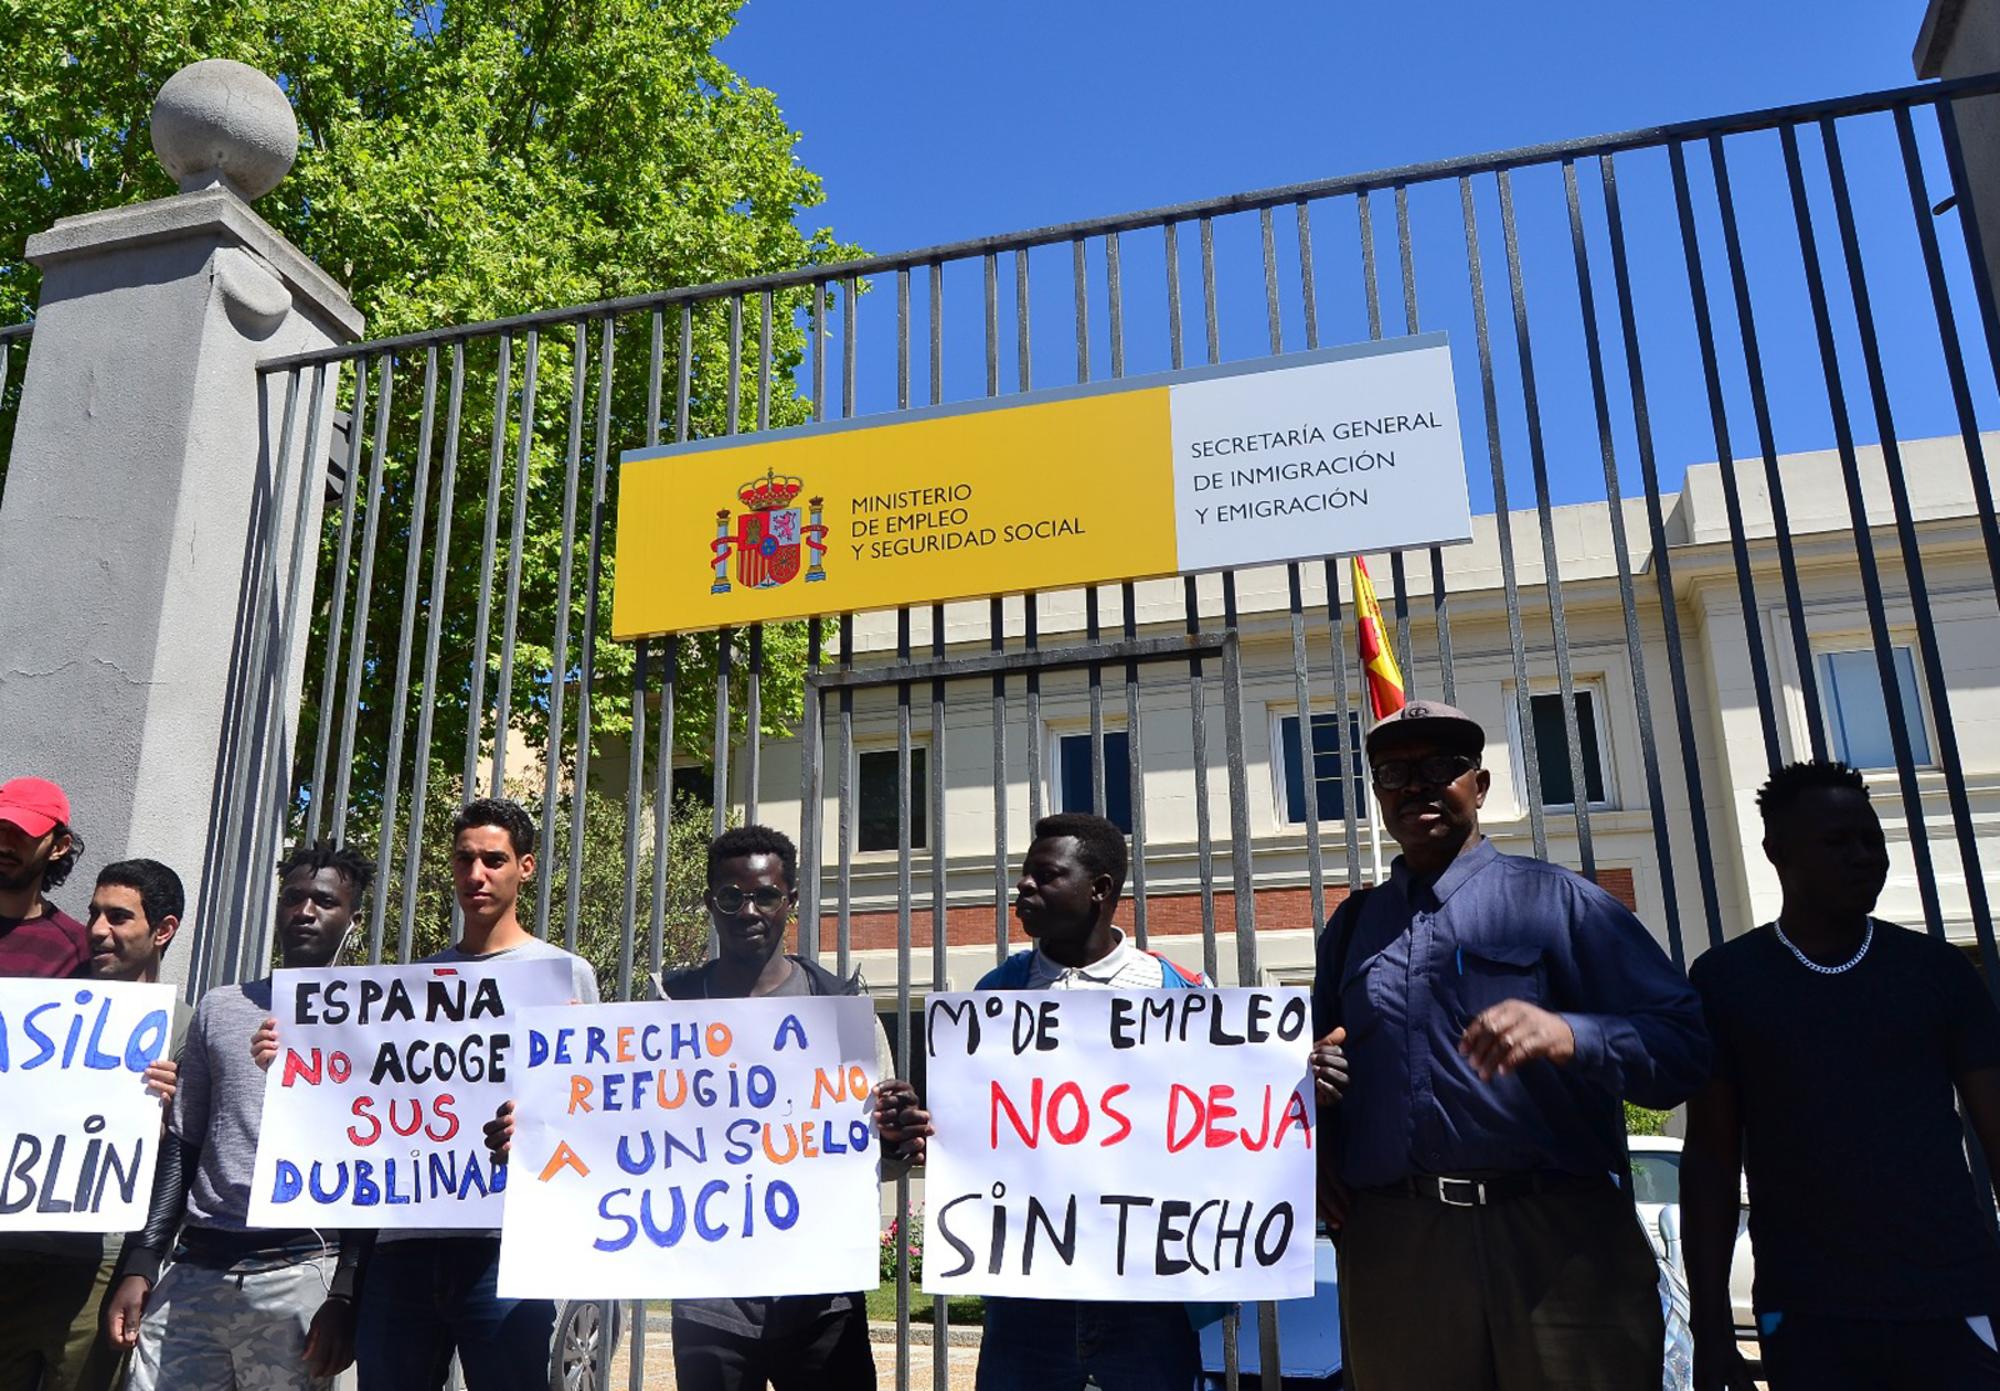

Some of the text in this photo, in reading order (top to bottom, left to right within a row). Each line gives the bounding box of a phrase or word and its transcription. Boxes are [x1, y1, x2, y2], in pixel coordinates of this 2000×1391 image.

[1191, 411, 1442, 459] SECRETARÍA GENERAL
[1193, 450, 1396, 492] DE INMIGRACIÓN
[851, 483, 972, 515] MINISTERIO
[851, 507, 968, 538] DE EMPLEO
[1195, 487, 1369, 525] Y EMIGRACIÓN
[851, 517, 1086, 561] Y SEGURIDAD SOCIAL
[294, 968, 506, 1025] ESPAÑA
[527, 1014, 809, 1069] DERECHO A
[1012, 1001, 1060, 1056] DE
[1110, 994, 1307, 1049] EMPLEO
[281, 1034, 511, 1088] NO ACOGE
[810, 1065, 869, 1110] NO
[346, 1095, 460, 1147] SUS
[990, 1077, 1311, 1154] NOS DEJA
[537, 1118, 869, 1182] A UN SUELO
[1100, 1195, 1295, 1277] TECHO
